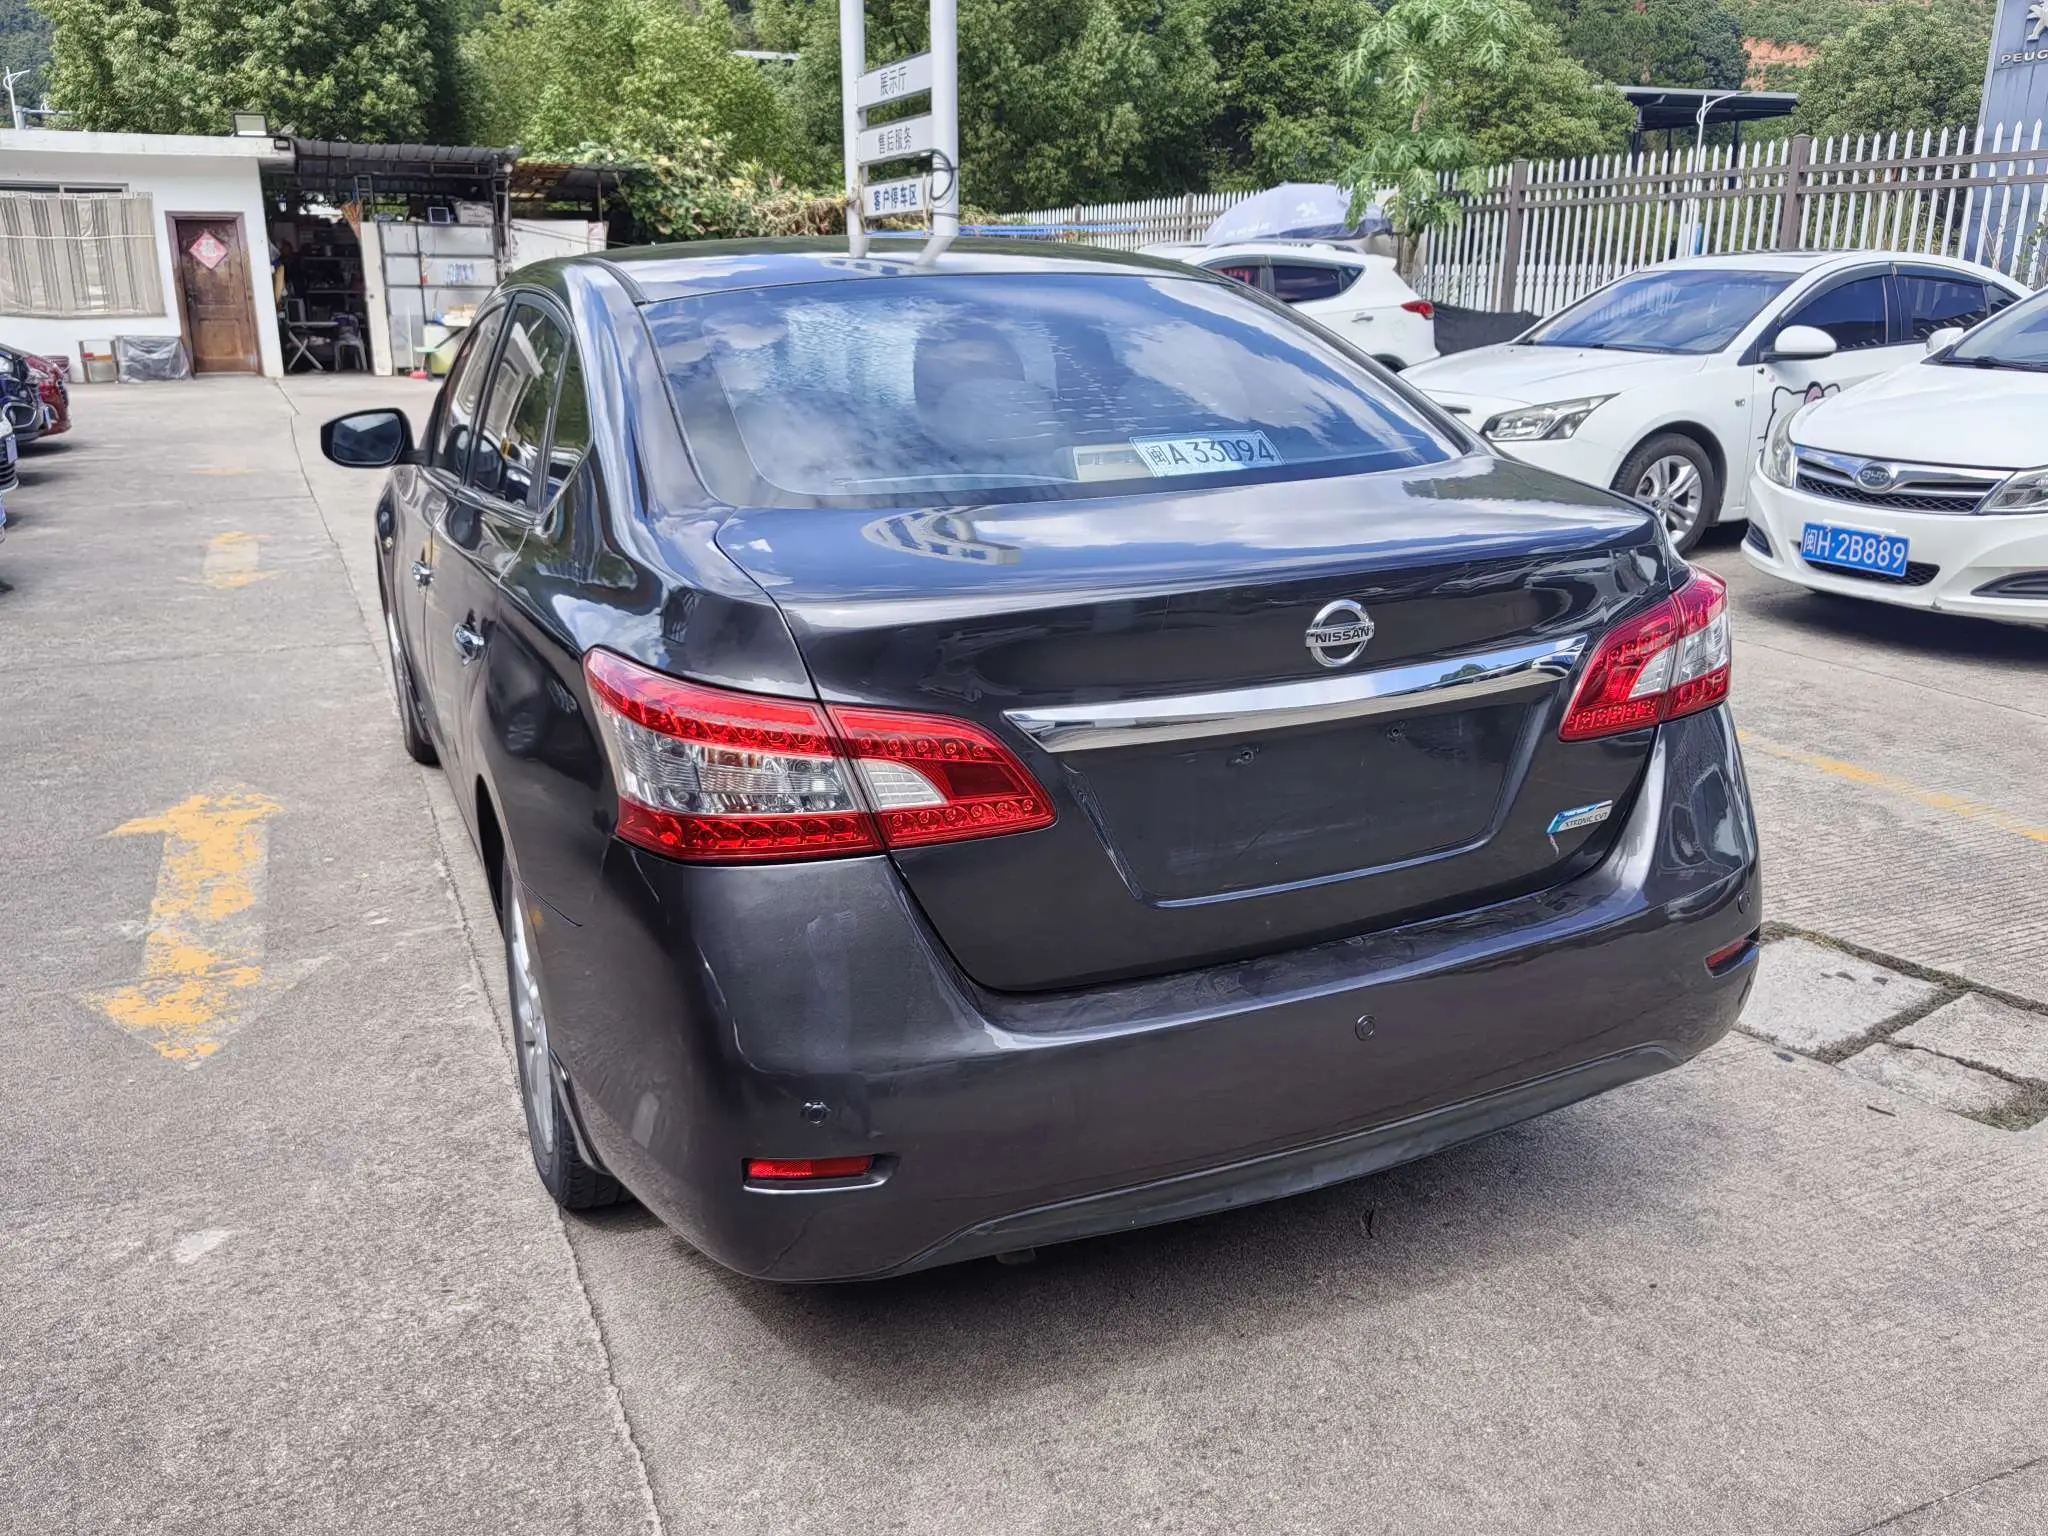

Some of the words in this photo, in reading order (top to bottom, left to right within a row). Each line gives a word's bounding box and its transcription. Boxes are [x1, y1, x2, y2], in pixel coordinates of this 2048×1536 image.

[880, 66, 907, 96] 展示厅
[878, 127, 911, 155] 售后服务
[873, 184, 918, 211] 客户停车区
[1315, 625, 1370, 643] NISSAN
[1565, 815, 1593, 828] XTRONIC
